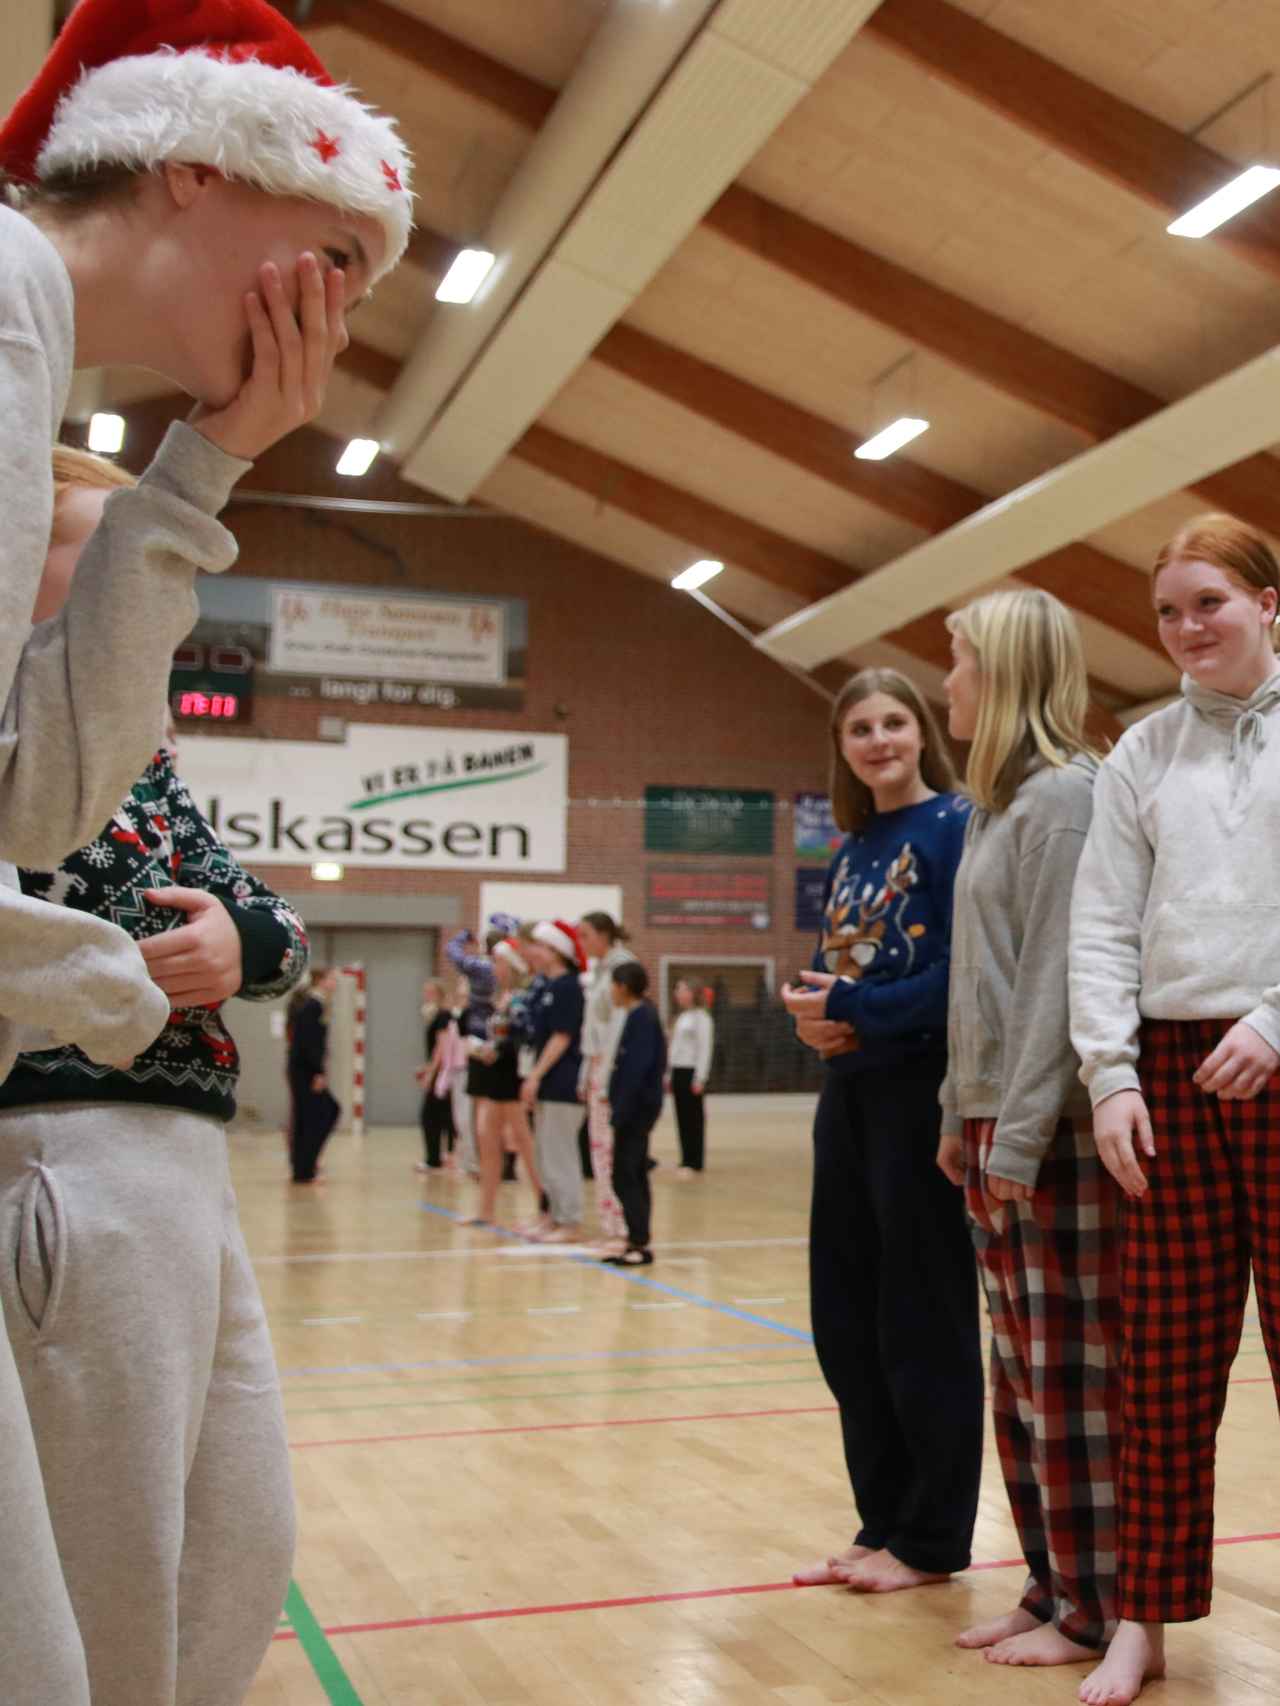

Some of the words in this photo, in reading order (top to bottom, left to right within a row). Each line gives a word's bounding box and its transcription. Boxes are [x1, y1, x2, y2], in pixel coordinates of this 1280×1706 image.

[382, 680, 414, 702] for
[361, 773, 383, 793] VI
[391, 765, 419, 785] ER
[464, 743, 535, 774] BANEN
[208, 799, 530, 859] lskassen
